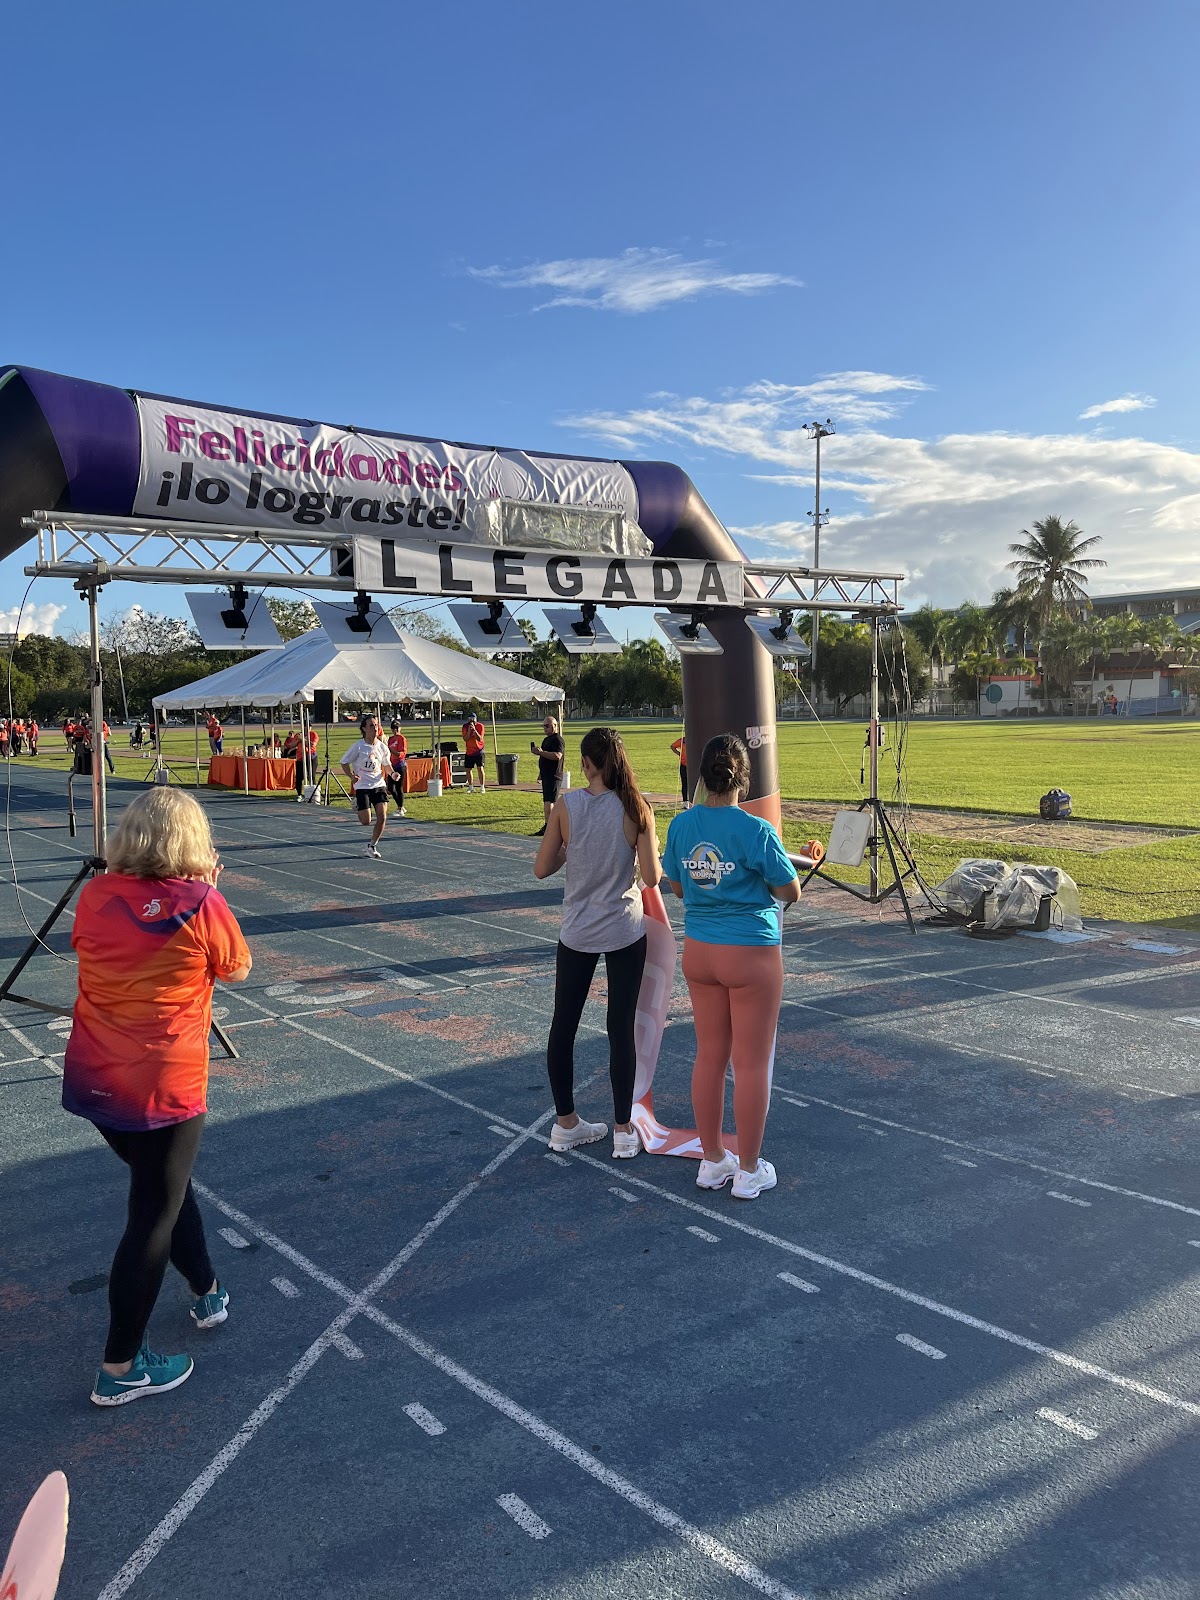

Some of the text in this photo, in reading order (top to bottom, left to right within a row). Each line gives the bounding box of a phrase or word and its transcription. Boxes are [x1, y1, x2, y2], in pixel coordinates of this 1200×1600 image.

[156, 462, 466, 531] ¡lo lograste!
[380, 539, 728, 602] LLEGADA
[681, 860, 736, 871] TORNEO
[142, 898, 161, 917] 25
